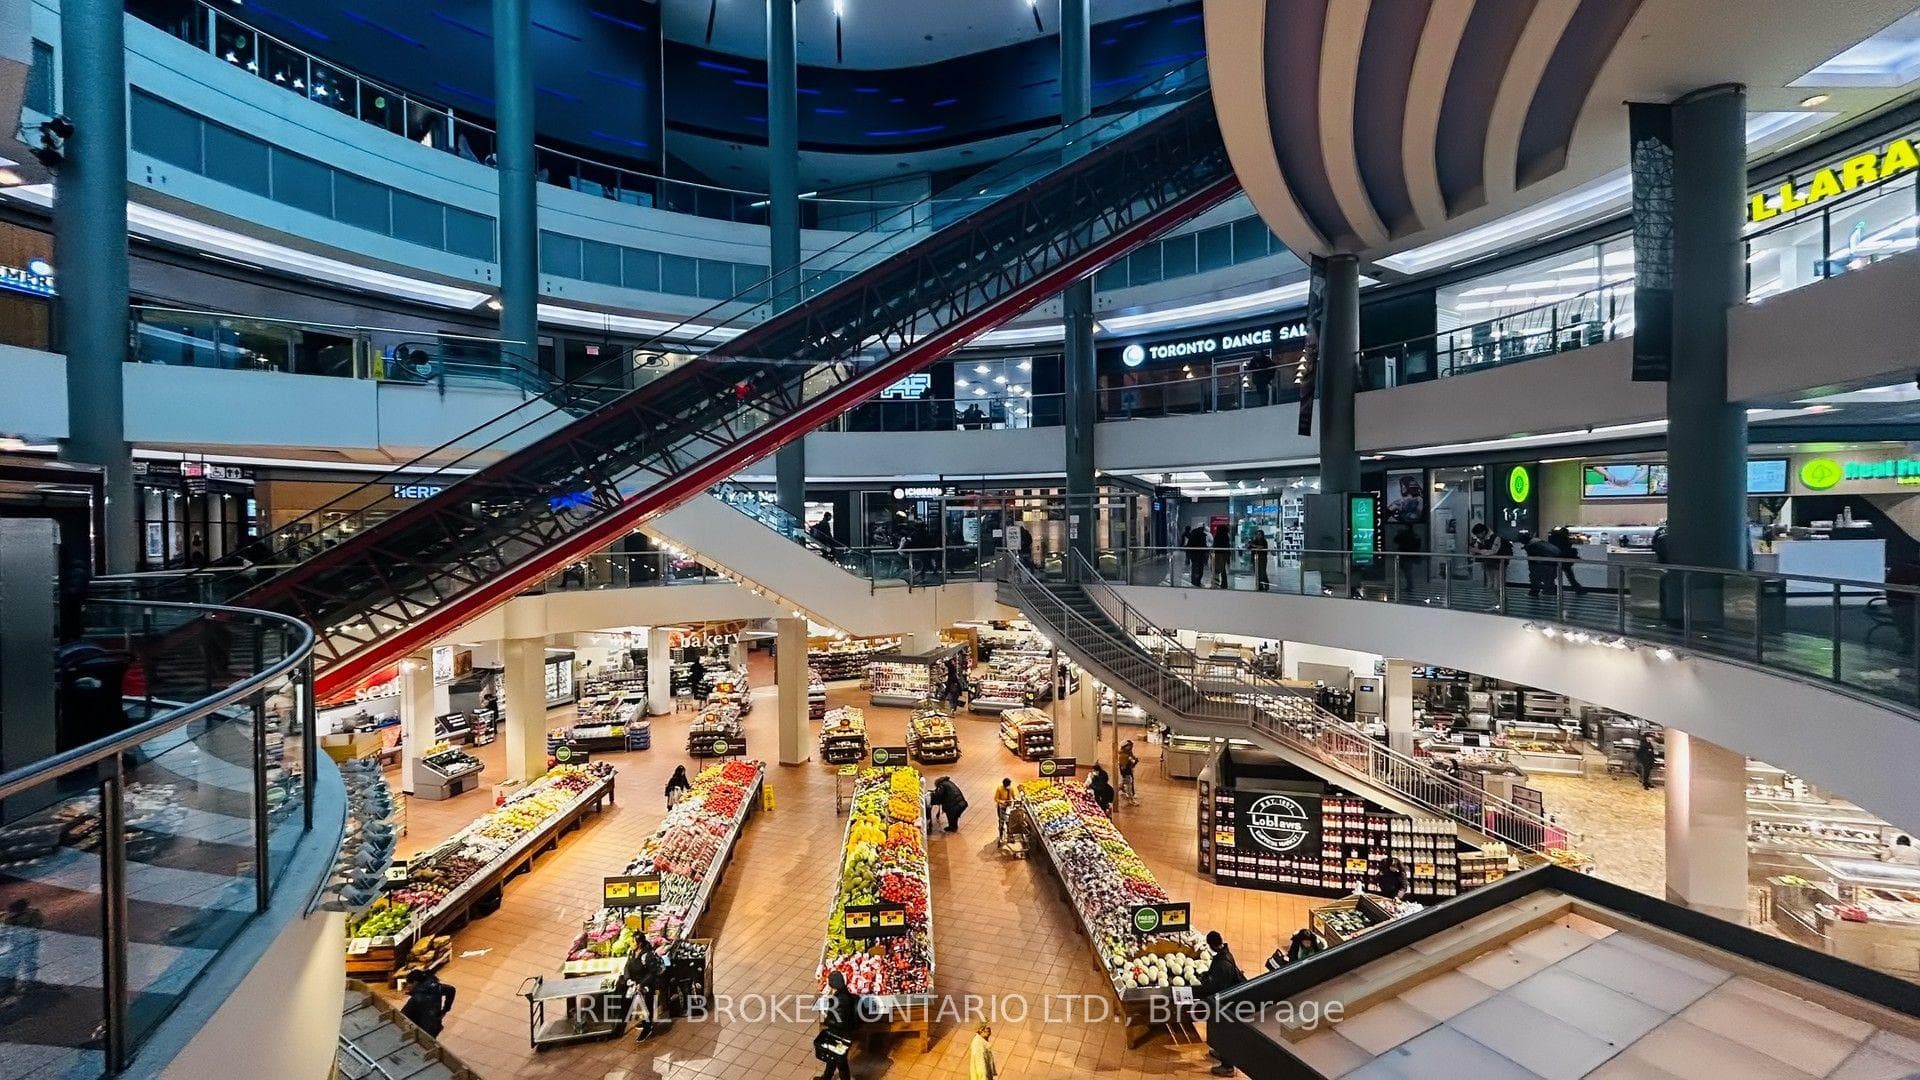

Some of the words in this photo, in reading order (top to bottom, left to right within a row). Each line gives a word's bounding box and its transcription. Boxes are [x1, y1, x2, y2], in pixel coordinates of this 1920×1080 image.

[1149, 339, 1216, 360] TORONTO
[1222, 330, 1272, 350] DANCE
[680, 631, 740, 648] bakery
